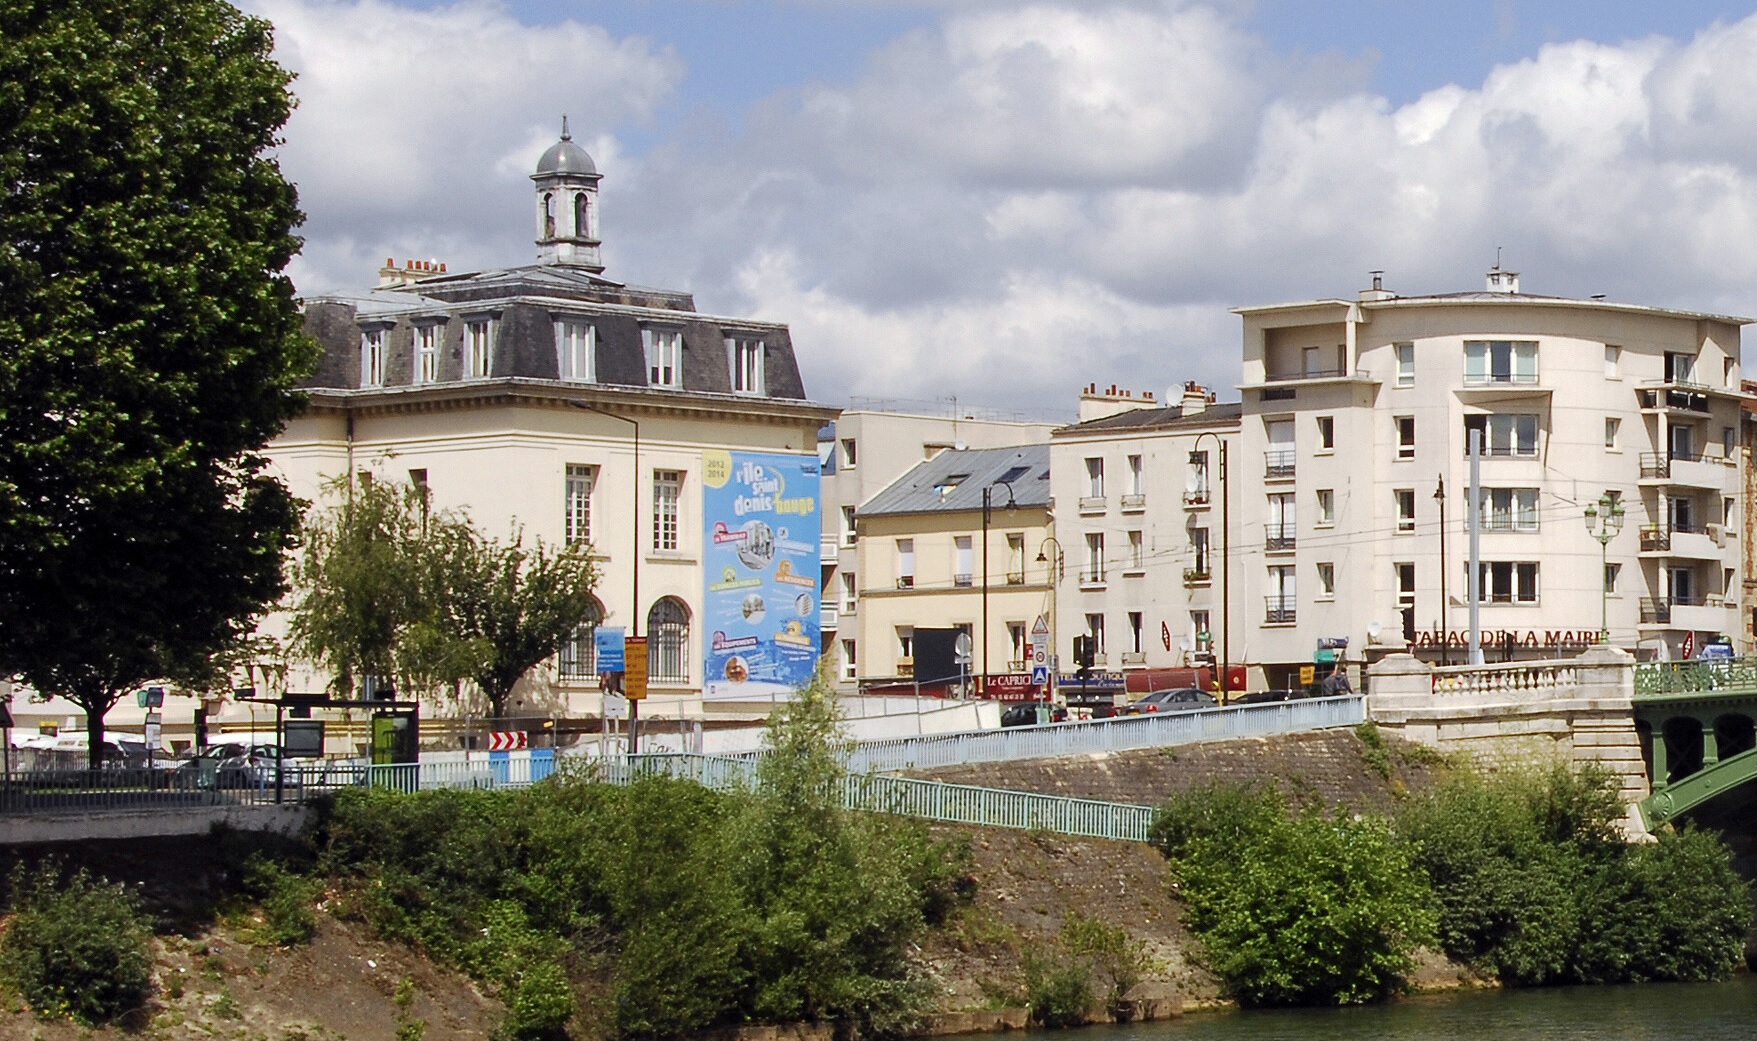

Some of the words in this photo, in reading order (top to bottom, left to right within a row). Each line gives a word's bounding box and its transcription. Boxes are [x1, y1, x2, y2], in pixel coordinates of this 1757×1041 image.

[707, 460, 725, 468] 2012
[707, 469, 725, 478] 2014
[752, 477, 779, 496] saint
[734, 494, 772, 516] denis
[1480, 630, 1504, 646] DE
[1514, 630, 1538, 646] LA
[987, 676, 996, 686] Le
